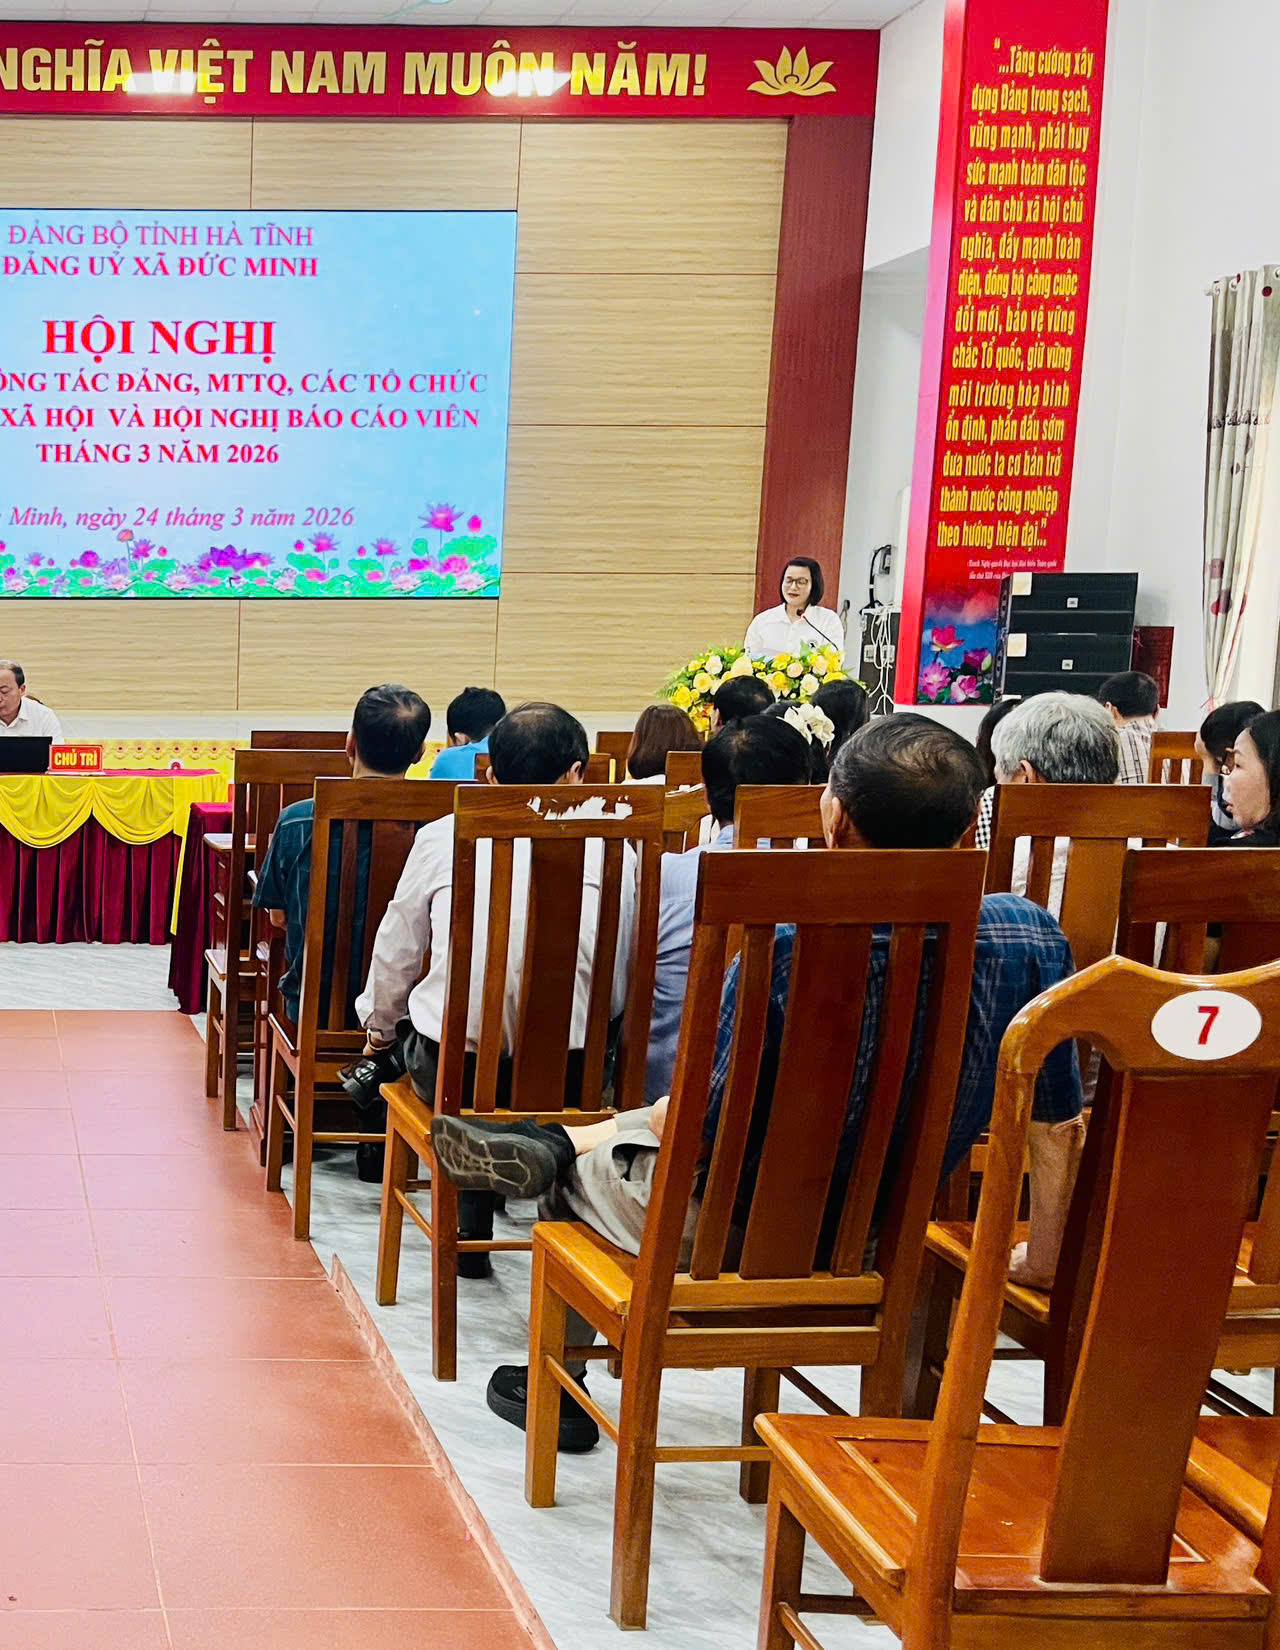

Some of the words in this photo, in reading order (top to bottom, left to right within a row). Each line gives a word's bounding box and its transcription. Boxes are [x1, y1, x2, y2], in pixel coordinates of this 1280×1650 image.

[150, 38, 254, 104] VIỆT
[270, 50, 386, 95] NAM
[402, 40, 554, 96] MUÔN
[570, 41, 706, 96] NĂM!
[1074, 48, 1093, 78] xây
[972, 84, 998, 116] dựng
[1001, 80, 1028, 114] Đảng
[1031, 86, 1059, 115] trong
[1062, 86, 1090, 118] sạch,
[970, 120, 997, 151] vững
[1000, 122, 1035, 153] mạnh,
[1039, 121, 1065, 152] phát
[1068, 122, 1089, 152] huy
[967, 157, 986, 185] sức
[988, 158, 1018, 191] mạnh
[1047, 158, 1066, 185] dân
[1069, 158, 1086, 191] tộc
[965, 194, 977, 222] và
[980, 194, 1000, 222] dân
[1003, 192, 1023, 222] chủ
[1026, 196, 1040, 222] xã
[1042, 195, 1060, 228] hội
[1063, 193, 1083, 222] chủ
[9, 220, 84, 244] ĐẢNG
[93, 220, 128, 249] BỘ
[136, 221, 197, 245] TỈNH
[207, 221, 243, 246] HÀ
[251, 223, 312, 246] TĨNH
[961, 232, 995, 262] nghĩa,
[1022, 233, 1053, 264] mạnh
[3, 251, 79, 275] ĐẢNG
[89, 251, 124, 276] UỶ
[133, 252, 170, 276] XÃ
[179, 252, 236, 276] ĐỨC
[245, 257, 317, 277] MINH
[956, 302, 974, 332] đổi
[977, 305, 1002, 335] mới,
[1006, 302, 1027, 332] bảo
[1031, 305, 1044, 338] vệ
[1048, 305, 1075, 335] vững
[42, 314, 135, 364] HỘI
[148, 320, 276, 364] NGHỊ
[54, 368, 109, 392] TÁC
[117, 368, 200, 395] ĐẢNG,
[208, 373, 294, 396] MTTQ,
[301, 369, 357, 392] CÁC
[364, 369, 402, 392] TỔ
[408, 369, 487, 393] CHỨC
[949, 380, 972, 406] môi
[1017, 380, 1039, 406] hòa
[1043, 380, 1069, 406] bình
[0, 403, 37, 427] XÃ
[45, 405, 94, 432] HỘI
[108, 403, 145, 428] VÀ
[153, 406, 202, 432] HỘI
[210, 409, 279, 433] NGHỊ
[288, 404, 344, 428] BÁO
[350, 404, 408, 428] CÁO
[416, 404, 478, 428] VIÊN
[36, 439, 131, 463] THÁNG
[138, 444, 150, 463] 3
[159, 440, 219, 463] NĂM
[227, 444, 279, 463] 2026
[943, 451, 962, 476] đưa
[965, 450, 991, 476] nước
[994, 452, 1005, 476] ta
[1008, 454, 1021, 476] cơ
[1023, 447, 1043, 476] bản
[1046, 448, 1062, 476] trở
[9, 507, 67, 528] Minh,
[76, 507, 127, 530] ngày
[133, 507, 159, 526] 24
[166, 507, 225, 531] tháng
[232, 507, 244, 526] 3
[251, 509, 295, 526] năm
[302, 507, 354, 526] 2026
[938, 521, 959, 546] theo
[996, 520, 1019, 552] hiện
[54, 749, 78, 766] CHỦ
[80, 750, 97, 766] TRÌ
[1198, 1006, 1220, 1045] 7
